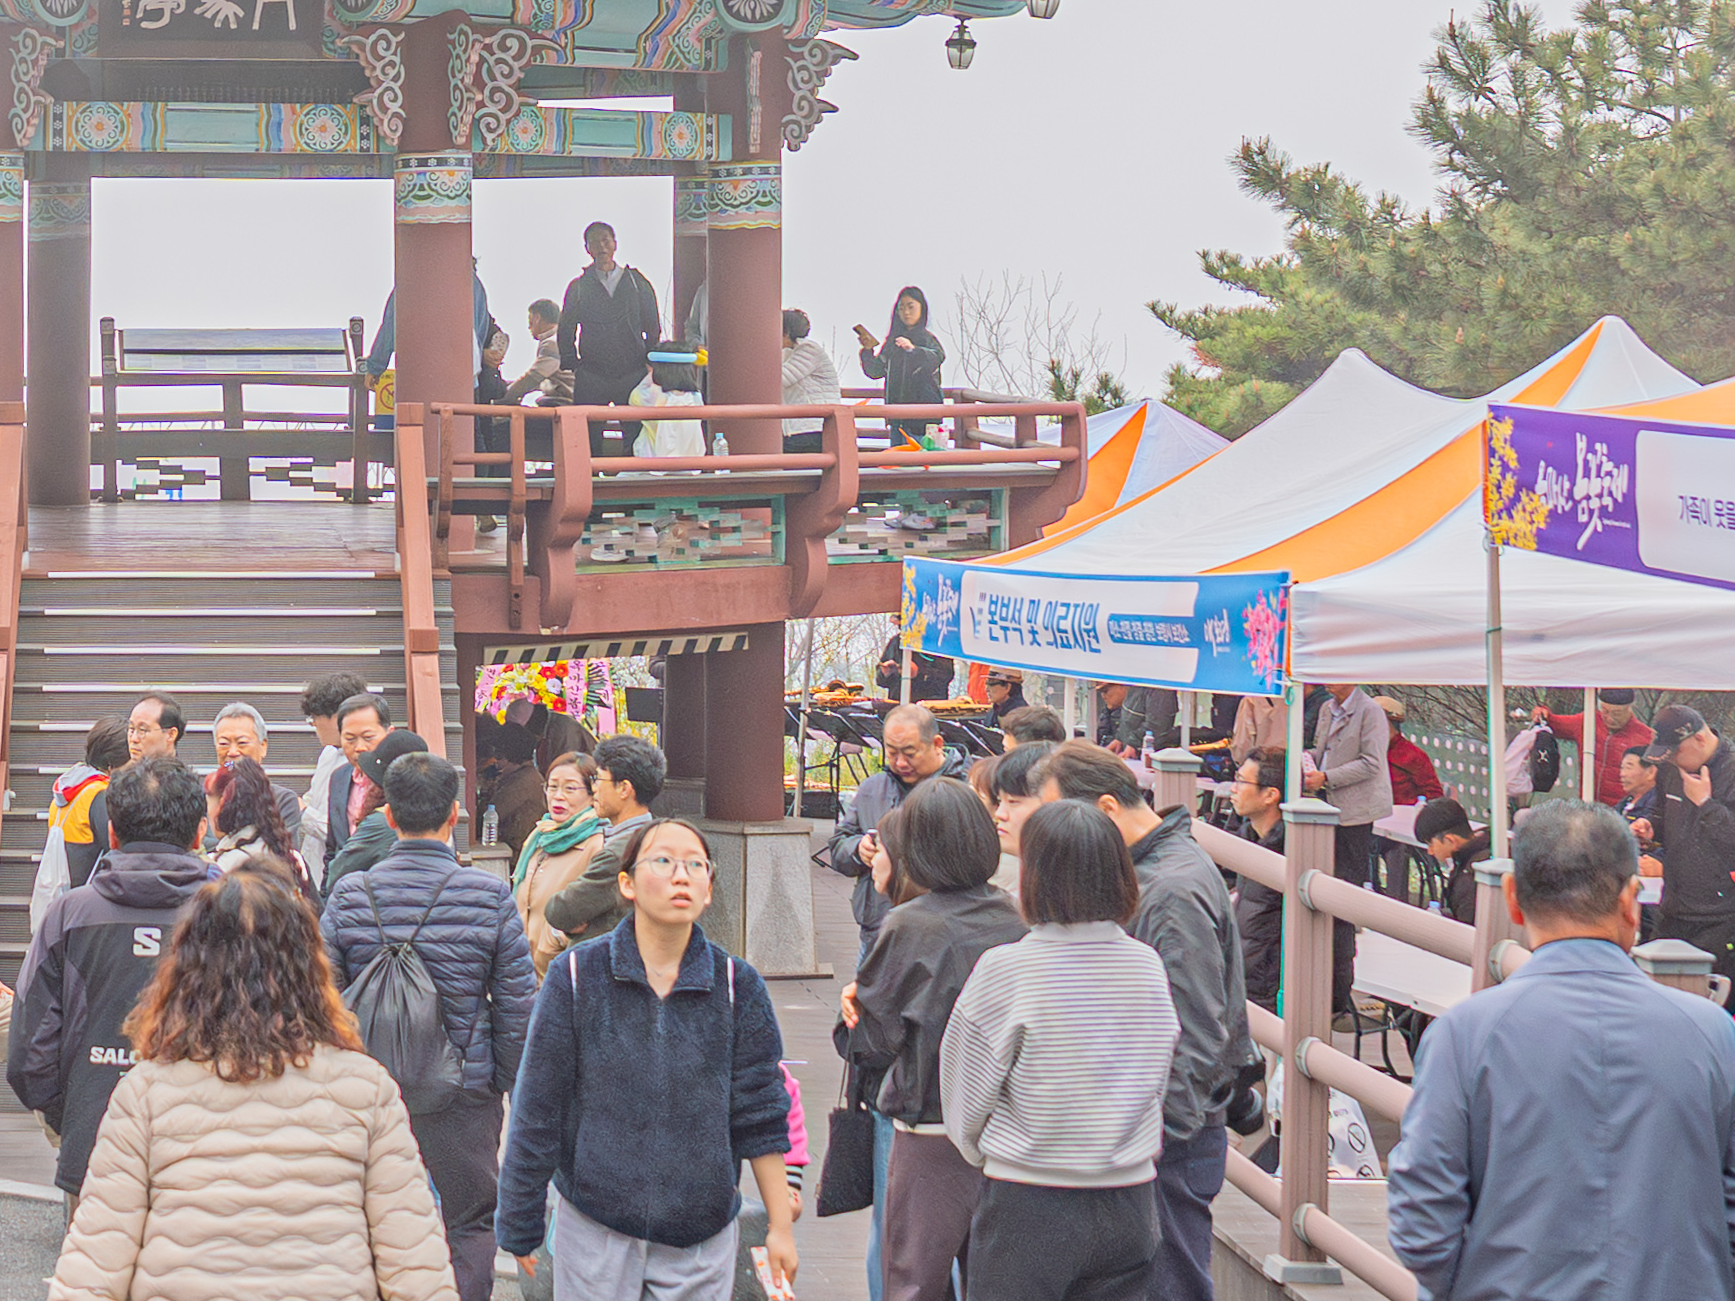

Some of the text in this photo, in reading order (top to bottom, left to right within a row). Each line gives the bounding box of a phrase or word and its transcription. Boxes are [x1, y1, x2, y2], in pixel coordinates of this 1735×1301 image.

[1678, 494, 1712, 528] 가족이
[987, 593, 1025, 646] 본부석
[1026, 598, 1042, 647] 및
[1042, 600, 1102, 654] 의료지원
[133, 927, 162, 957] S
